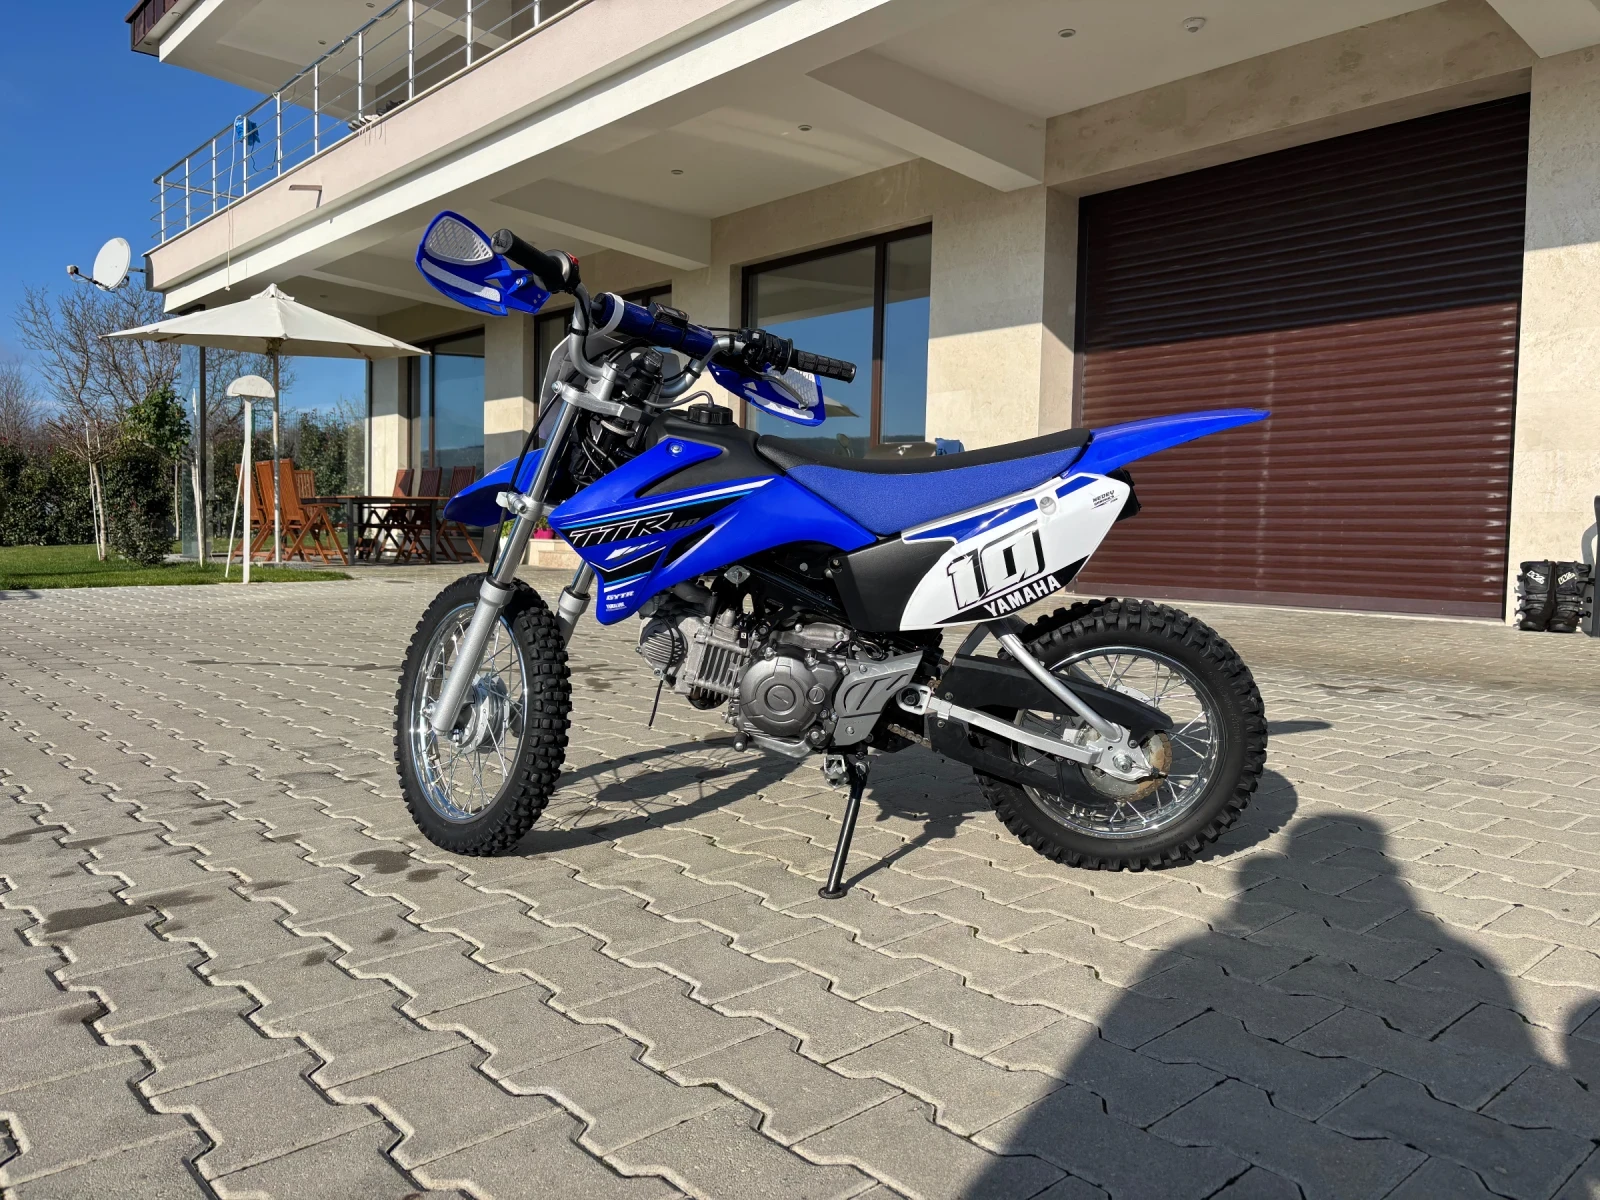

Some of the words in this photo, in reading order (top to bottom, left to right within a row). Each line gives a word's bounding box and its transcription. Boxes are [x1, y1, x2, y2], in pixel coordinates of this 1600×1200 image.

[671, 517, 701, 529] 110
[946, 519, 1045, 610] 10
[606, 591, 634, 600] GYTR
[984, 576, 1062, 617] YAMAHA
